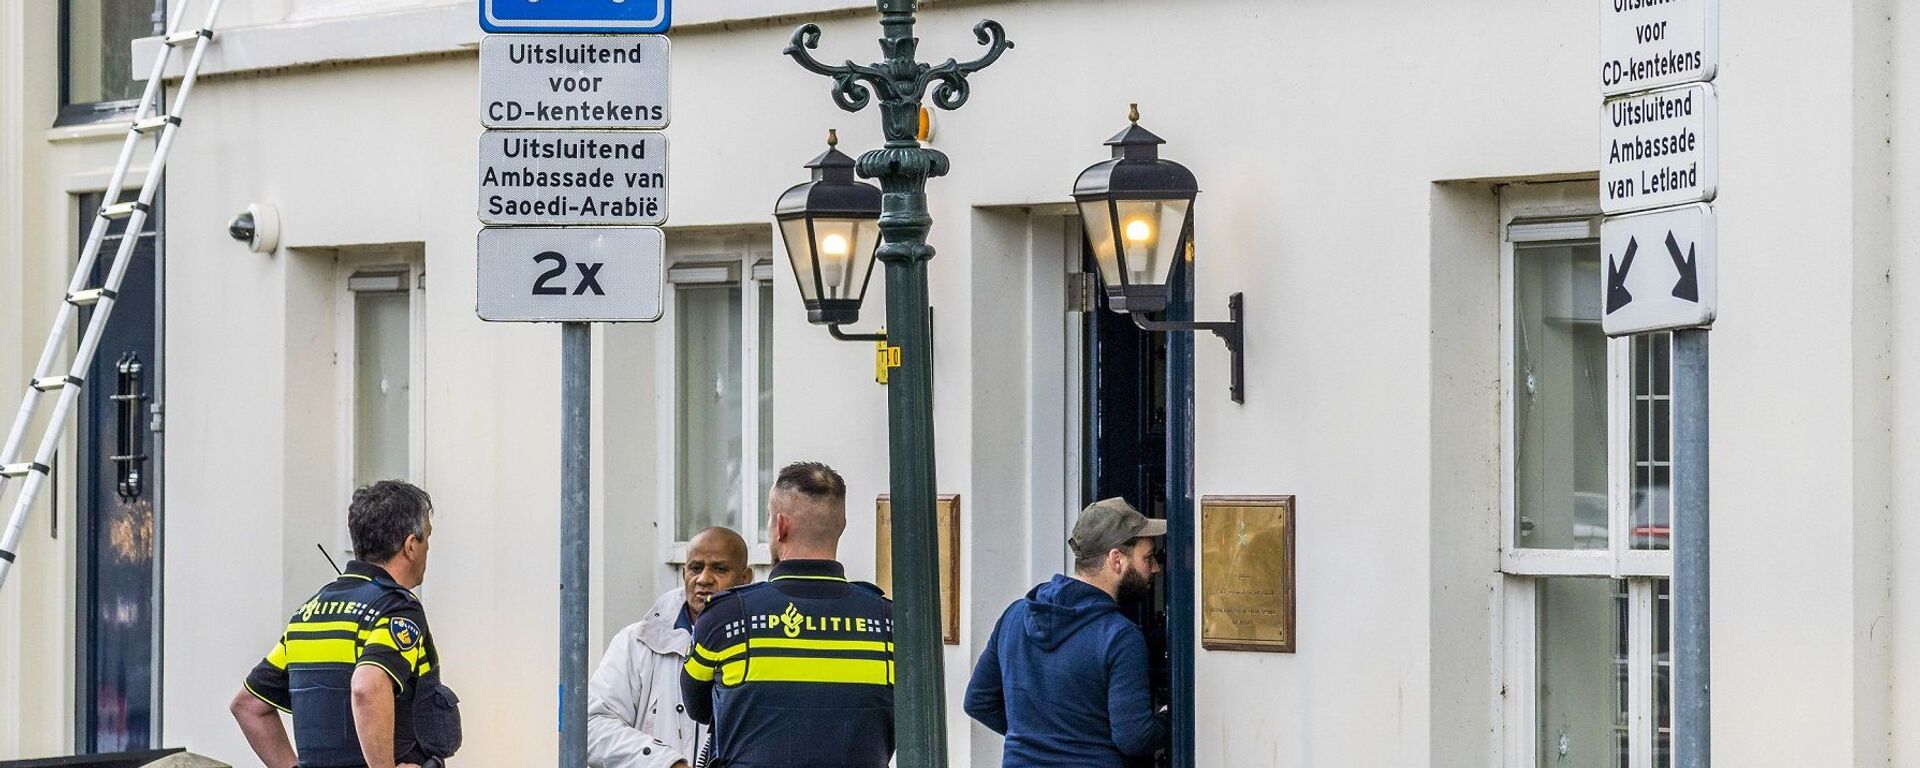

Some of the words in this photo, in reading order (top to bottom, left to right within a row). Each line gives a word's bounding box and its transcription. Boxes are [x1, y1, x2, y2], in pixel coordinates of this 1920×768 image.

[1636, 21, 1667, 44] voor
[509, 43, 641, 64] Uitsluitend
[1602, 49, 1701, 86] CD-kentekens
[549, 76, 602, 93] voor
[488, 101, 663, 122] CD-kentekens
[1612, 90, 1692, 127] Uitsluitend
[503, 138, 645, 160] Uitsluitend
[1609, 127, 1696, 164] Ambassade
[482, 167, 614, 188] Ambassade
[625, 172, 664, 189] van
[1608, 178, 1634, 200] van
[1641, 162, 1697, 195] Letland
[488, 195, 658, 217] Saoedi-Arabië
[531, 251, 606, 296] 2x
